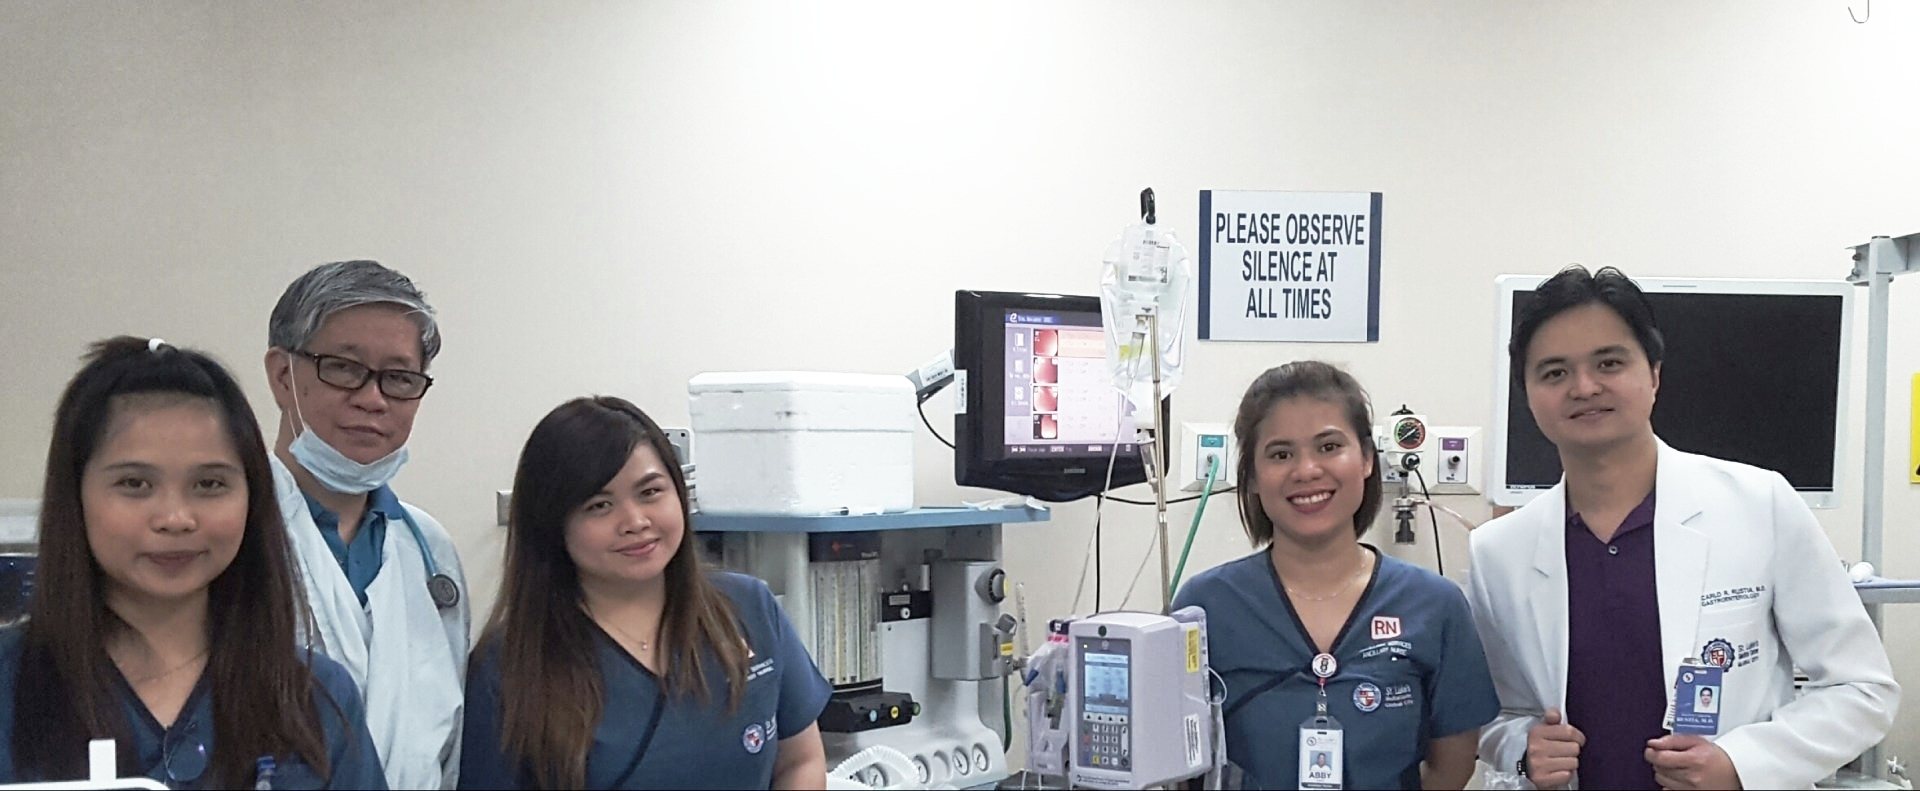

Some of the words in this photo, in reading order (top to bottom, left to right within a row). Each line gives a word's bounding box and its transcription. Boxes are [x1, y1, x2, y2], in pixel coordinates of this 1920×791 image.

[1216, 213, 1281, 244] PLEASE
[1286, 213, 1365, 245] OBSERVE
[1242, 250, 1312, 281] SILENCE
[1316, 251, 1338, 282] AT
[1246, 287, 1277, 318] ALL
[1282, 288, 1332, 319] TIMES
[1701, 591, 1721, 601] CARLO
[1701, 592, 1760, 606] GASTROENTEROLOGY
[1374, 620, 1397, 635] RN
